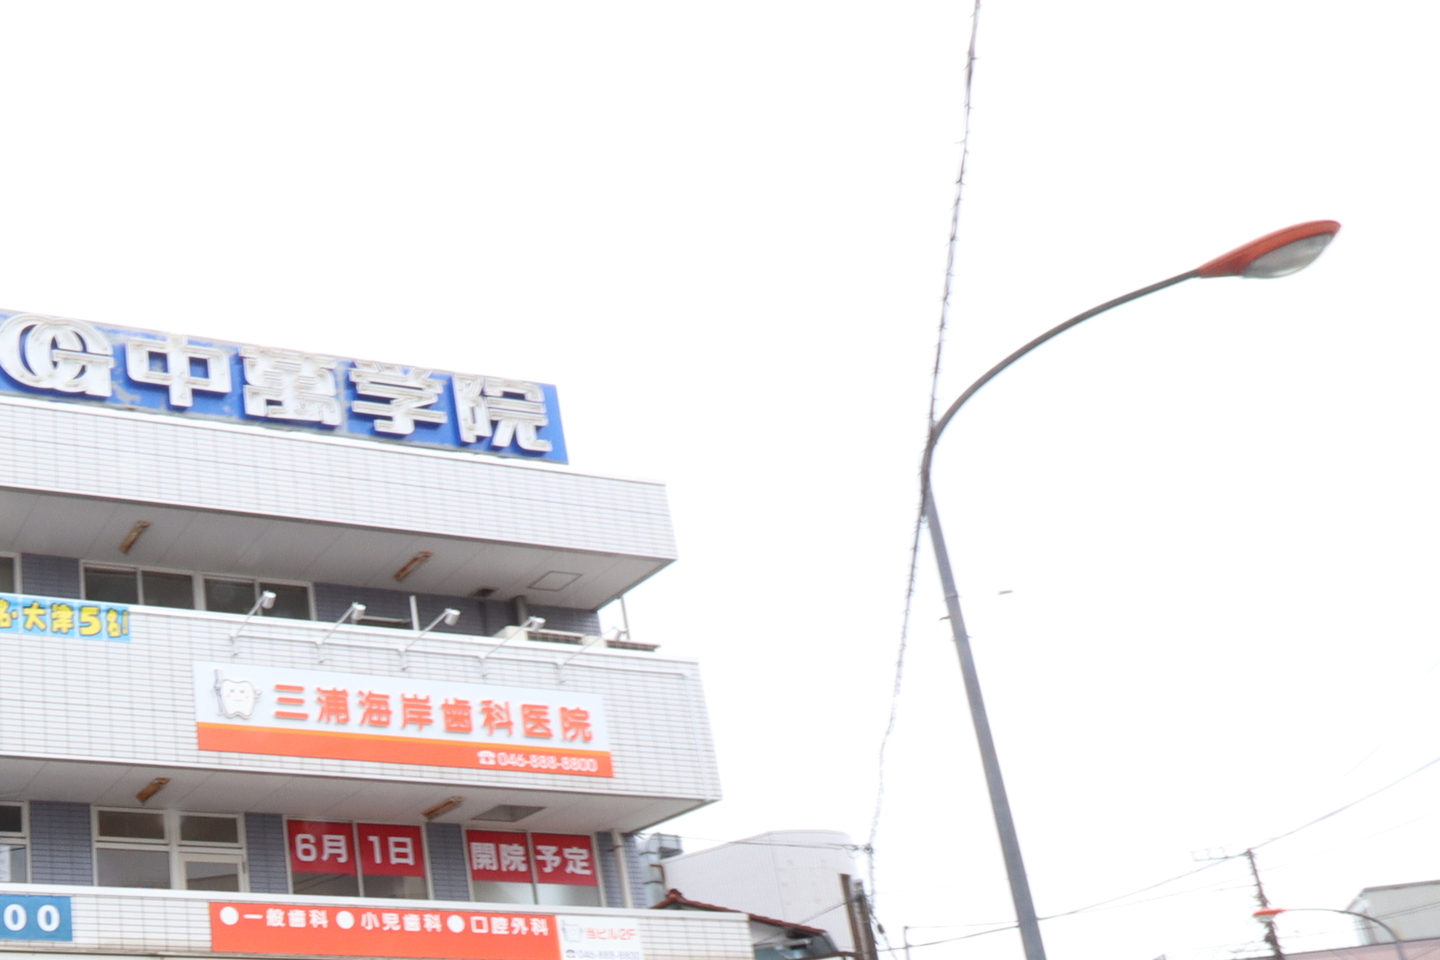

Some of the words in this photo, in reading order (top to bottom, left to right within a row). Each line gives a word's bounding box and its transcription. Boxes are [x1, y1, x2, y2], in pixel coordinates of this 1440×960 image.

[124, 333, 553, 453] 中萬学院
[273, 683, 594, 743] 三浦海岸歯科医院
[468, 841, 594, 876] 開院予定
